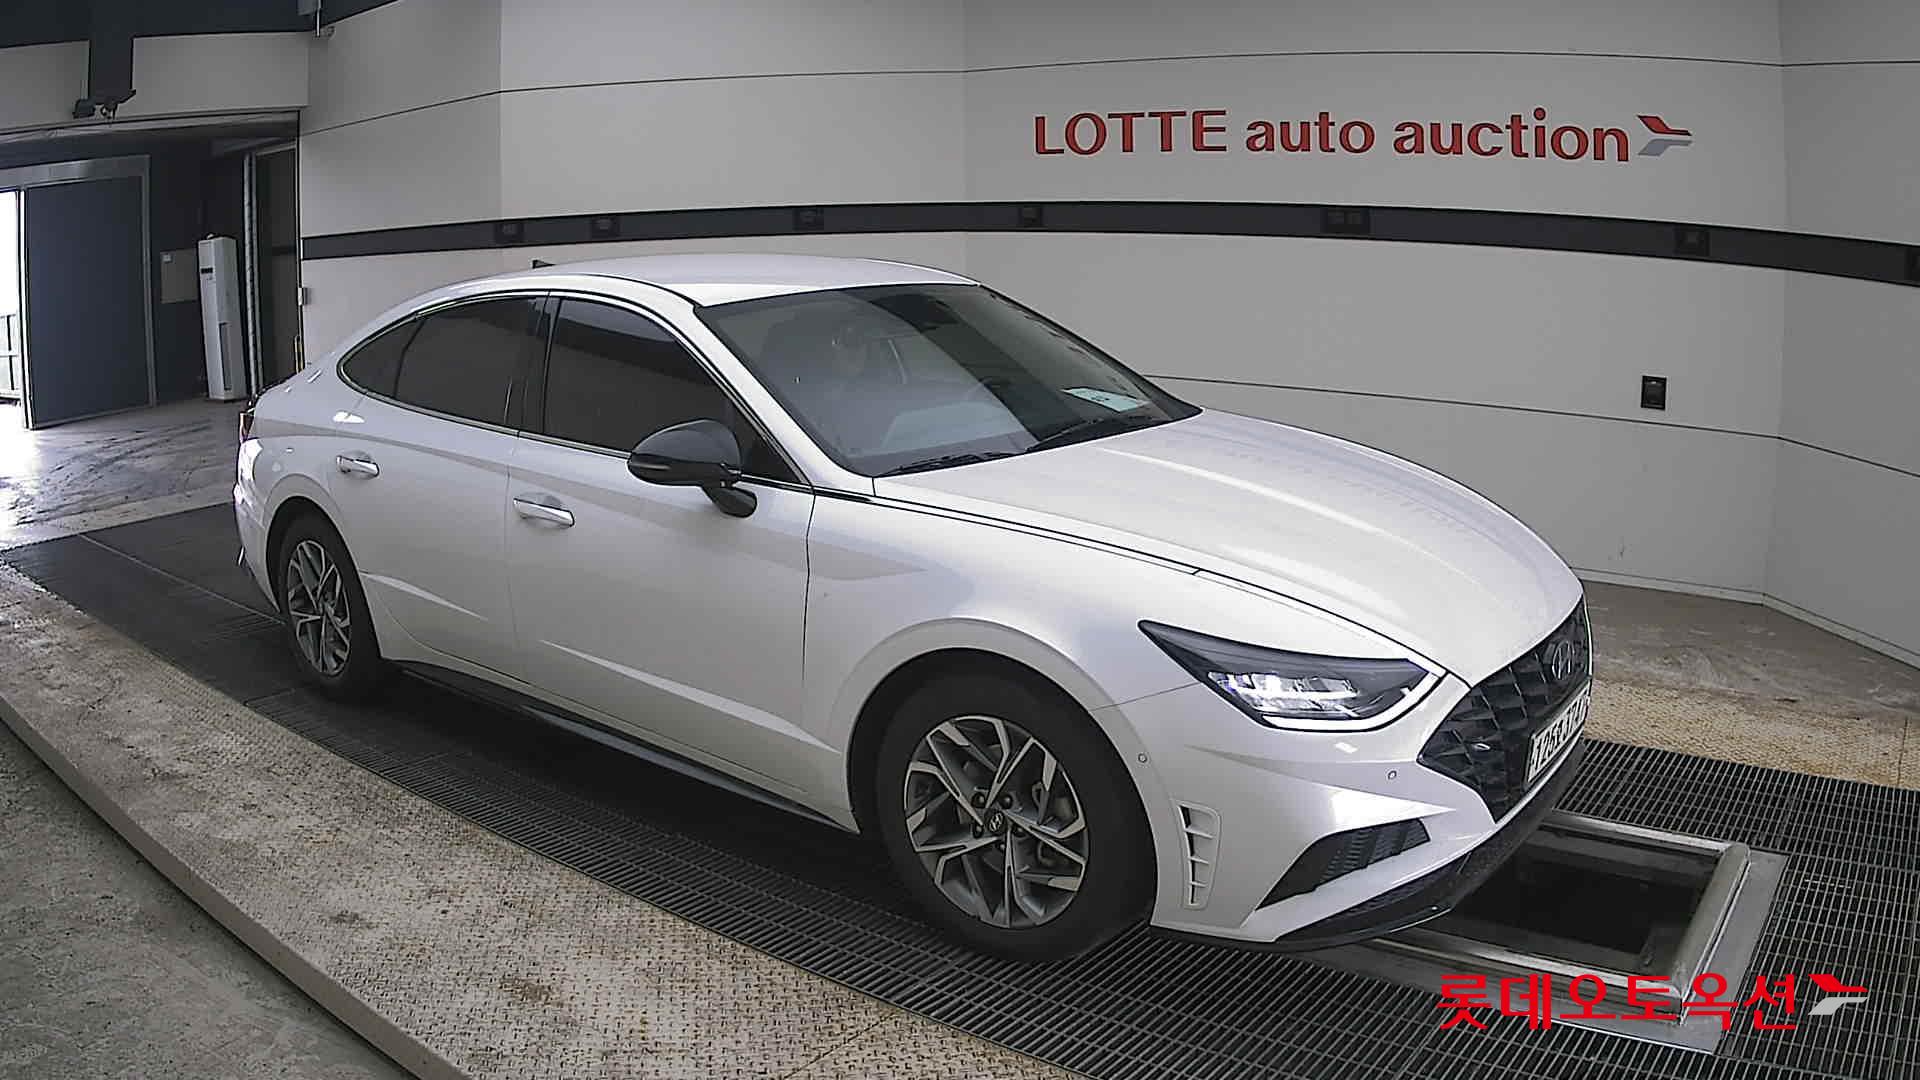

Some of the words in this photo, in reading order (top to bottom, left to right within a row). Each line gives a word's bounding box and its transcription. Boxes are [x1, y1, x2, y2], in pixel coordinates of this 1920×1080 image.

[1034, 110, 1227, 155] LOTTE
[1245, 111, 1375, 154] auto
[1392, 107, 1630, 162] auction
